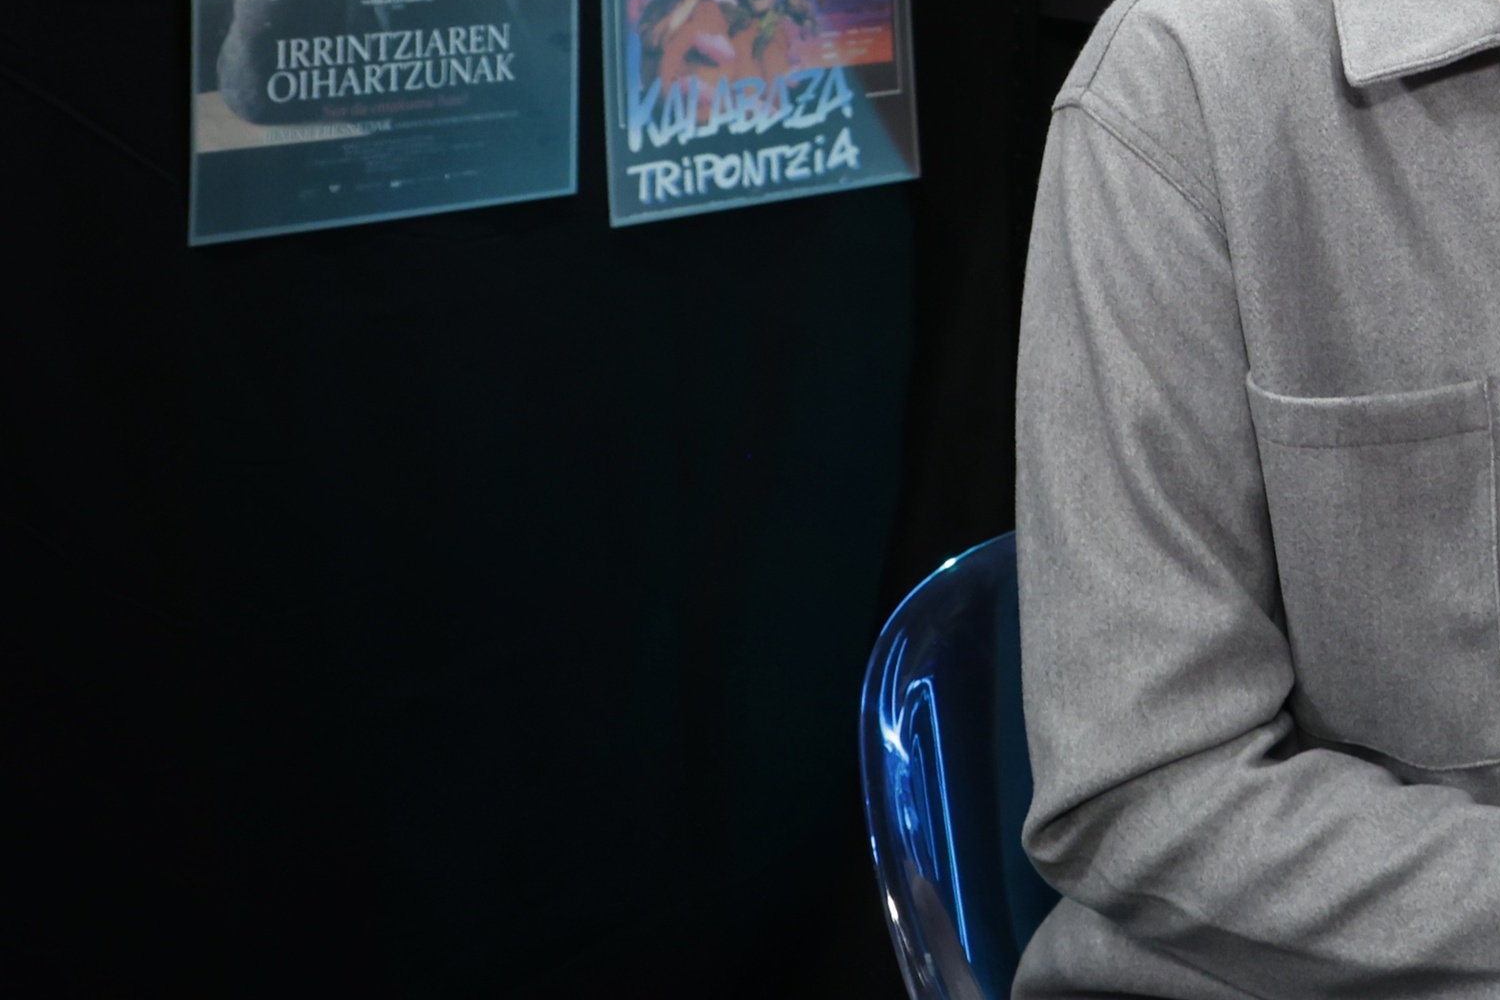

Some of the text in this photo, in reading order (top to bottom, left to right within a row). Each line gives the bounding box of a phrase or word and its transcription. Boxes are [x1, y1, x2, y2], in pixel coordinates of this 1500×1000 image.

[275, 22, 511, 70] IRRINTZIAREN
[267, 53, 516, 104] OIHARTZUNAK
[627, 32, 854, 153] KALABAZA
